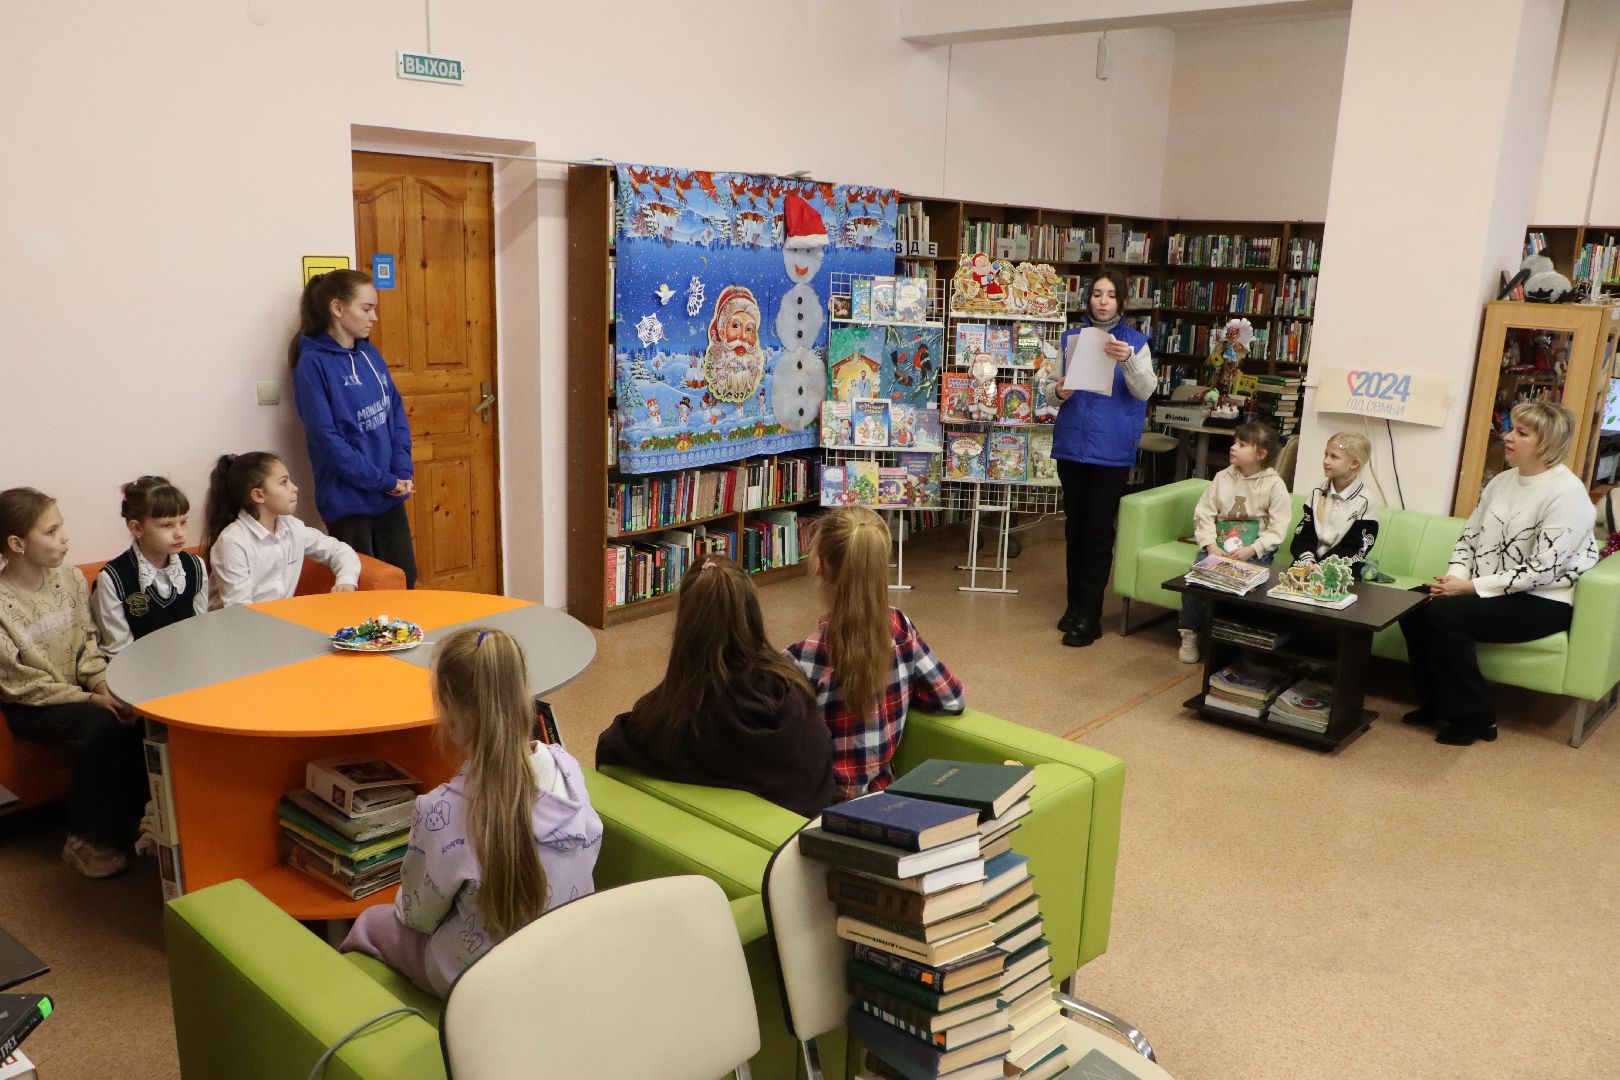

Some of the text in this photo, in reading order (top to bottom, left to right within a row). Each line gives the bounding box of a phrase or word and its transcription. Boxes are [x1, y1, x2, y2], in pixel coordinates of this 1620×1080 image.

[405, 56, 459, 79] ВЫХОД
[895, 242, 903, 254] В
[910, 241, 920, 255] Д
[928, 243, 936, 255] Е
[1353, 371, 1412, 403] 2024
